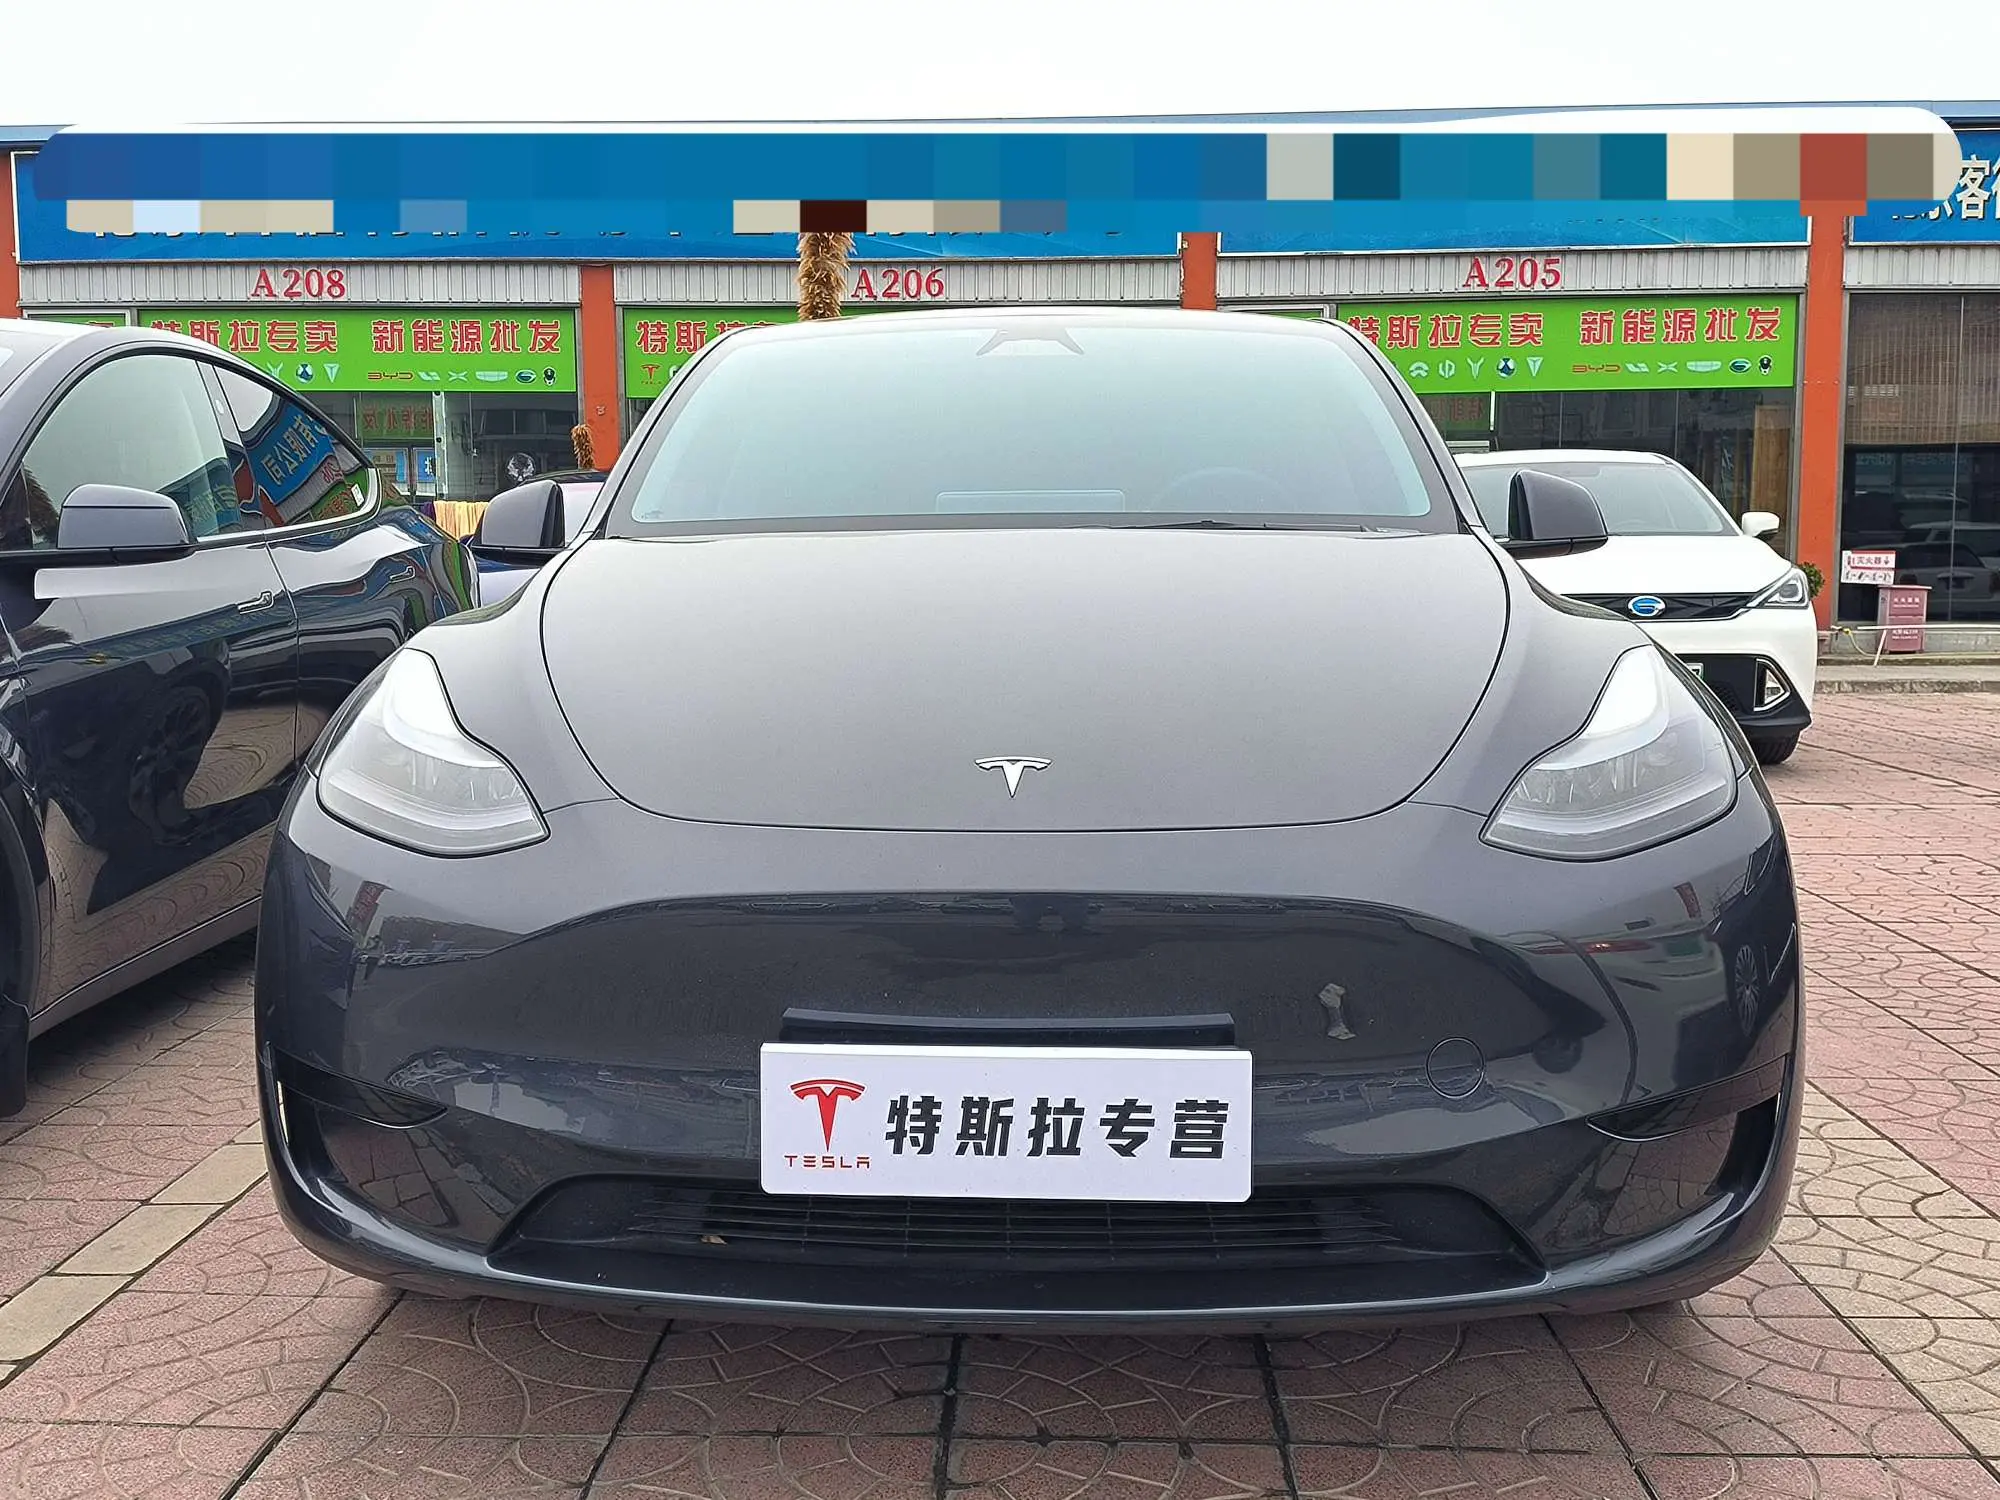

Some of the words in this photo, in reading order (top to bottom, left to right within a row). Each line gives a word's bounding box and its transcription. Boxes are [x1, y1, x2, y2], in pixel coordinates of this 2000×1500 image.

[250, 267, 346, 299] A208
[850, 267, 945, 299] A206
[1462, 256, 1561, 288] A205
[371, 319, 561, 354] 新能源批发
[1579, 307, 1781, 345] 新能源批发
[884, 1094, 1230, 1160] 特斯拉专营
[784, 1154, 871, 1169] TESLA
